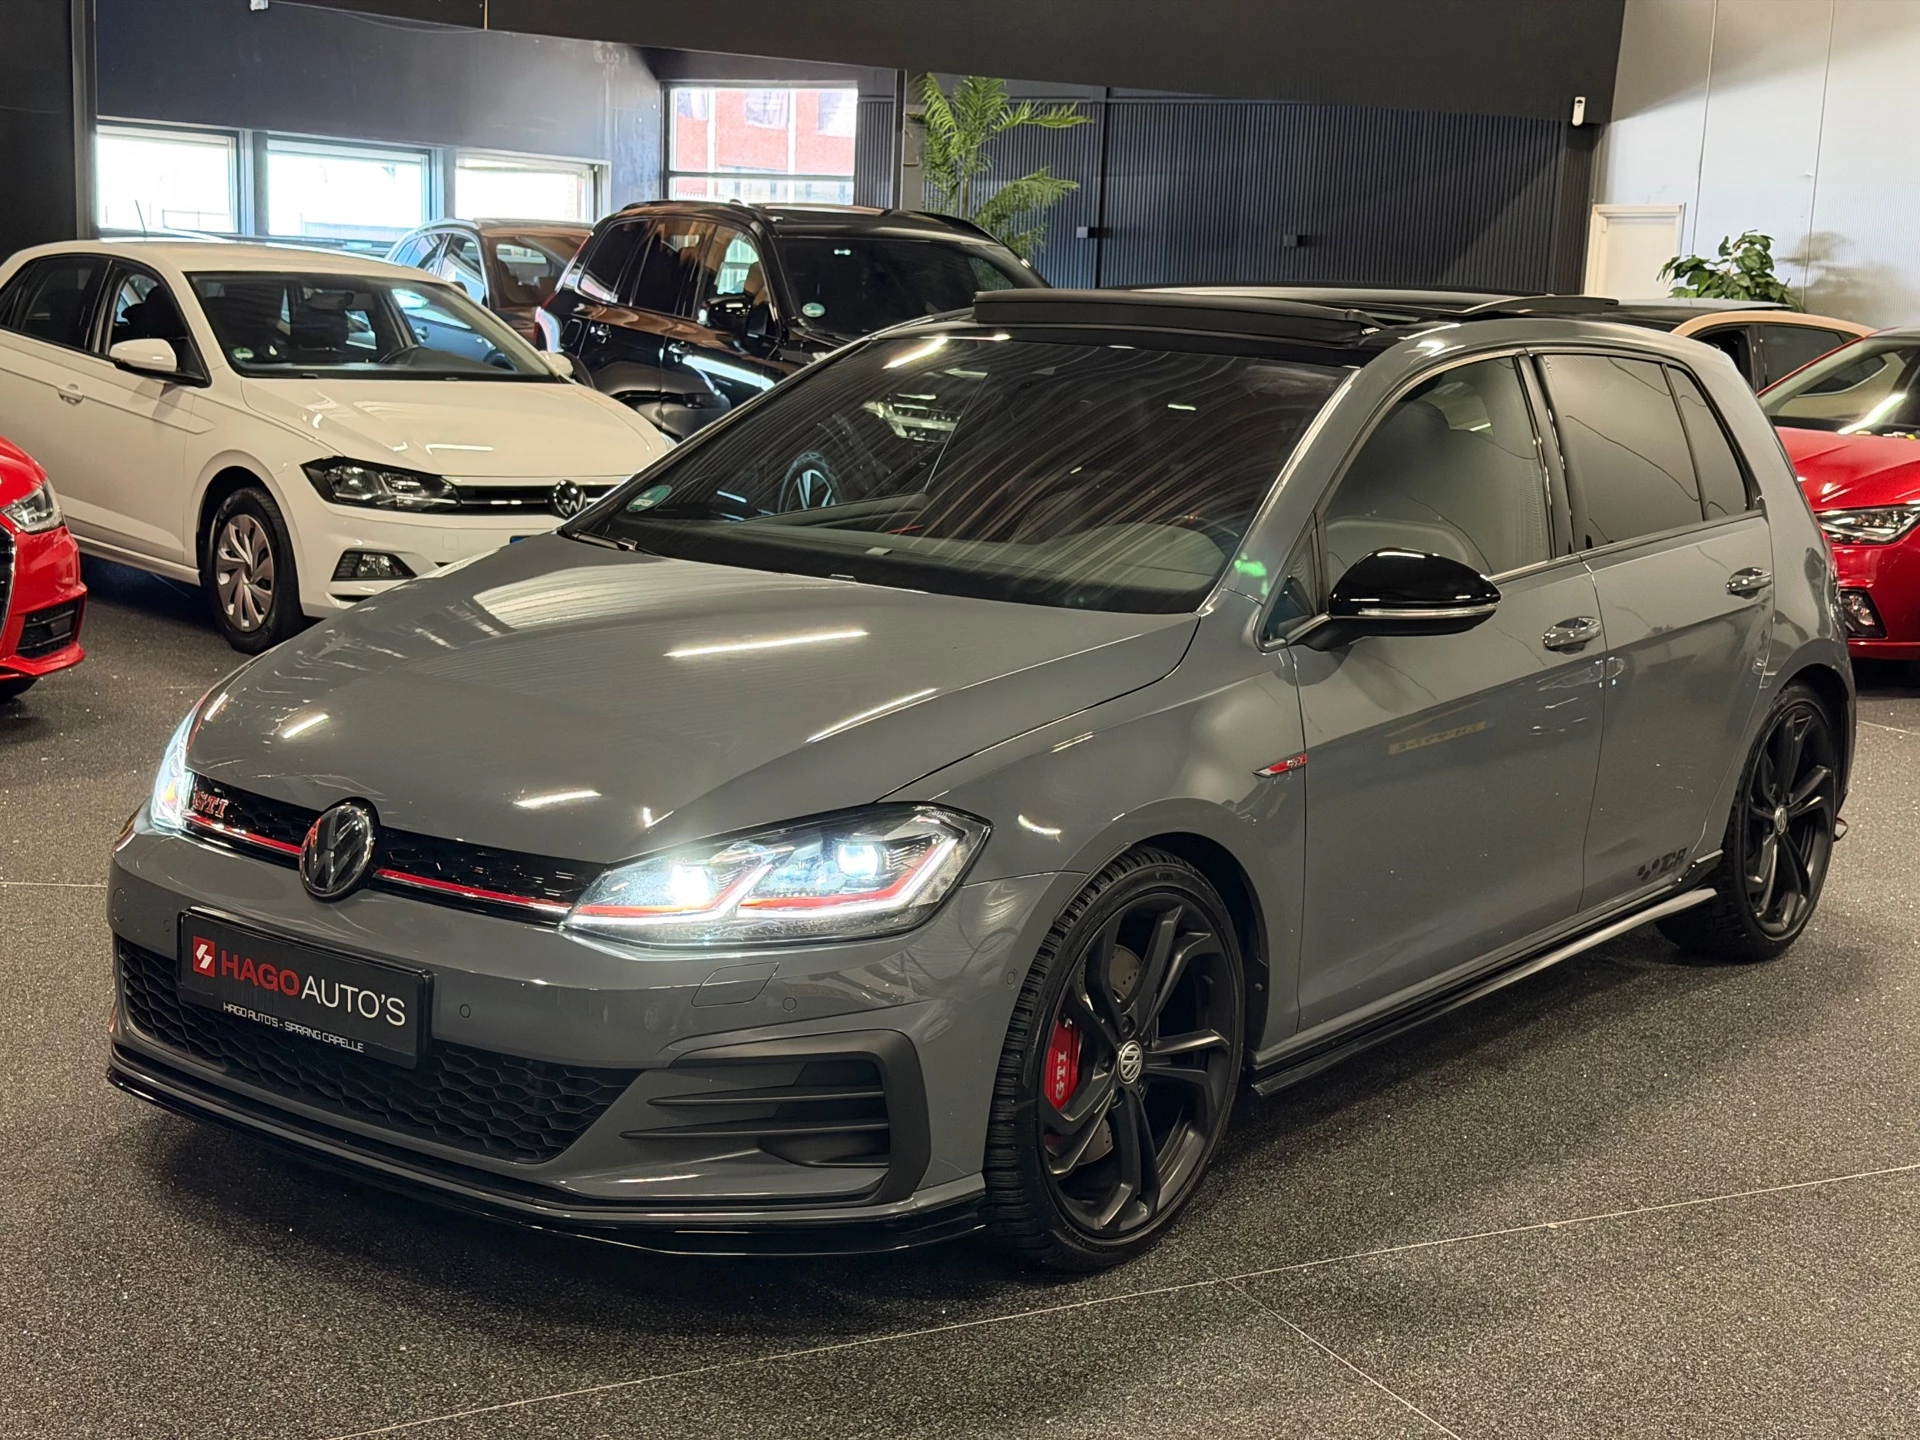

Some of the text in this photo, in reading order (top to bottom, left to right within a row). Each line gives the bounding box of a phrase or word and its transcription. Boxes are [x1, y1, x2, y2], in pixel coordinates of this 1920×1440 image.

[192, 791, 229, 818] GTI
[222, 1001, 247, 1019] HAGO
[247, 1008, 279, 1028] AUTO'S
[284, 1021, 321, 1042] SPRANG
[322, 1032, 364, 1053] CAPELLE
[1055, 1050, 1067, 1100] GTI
